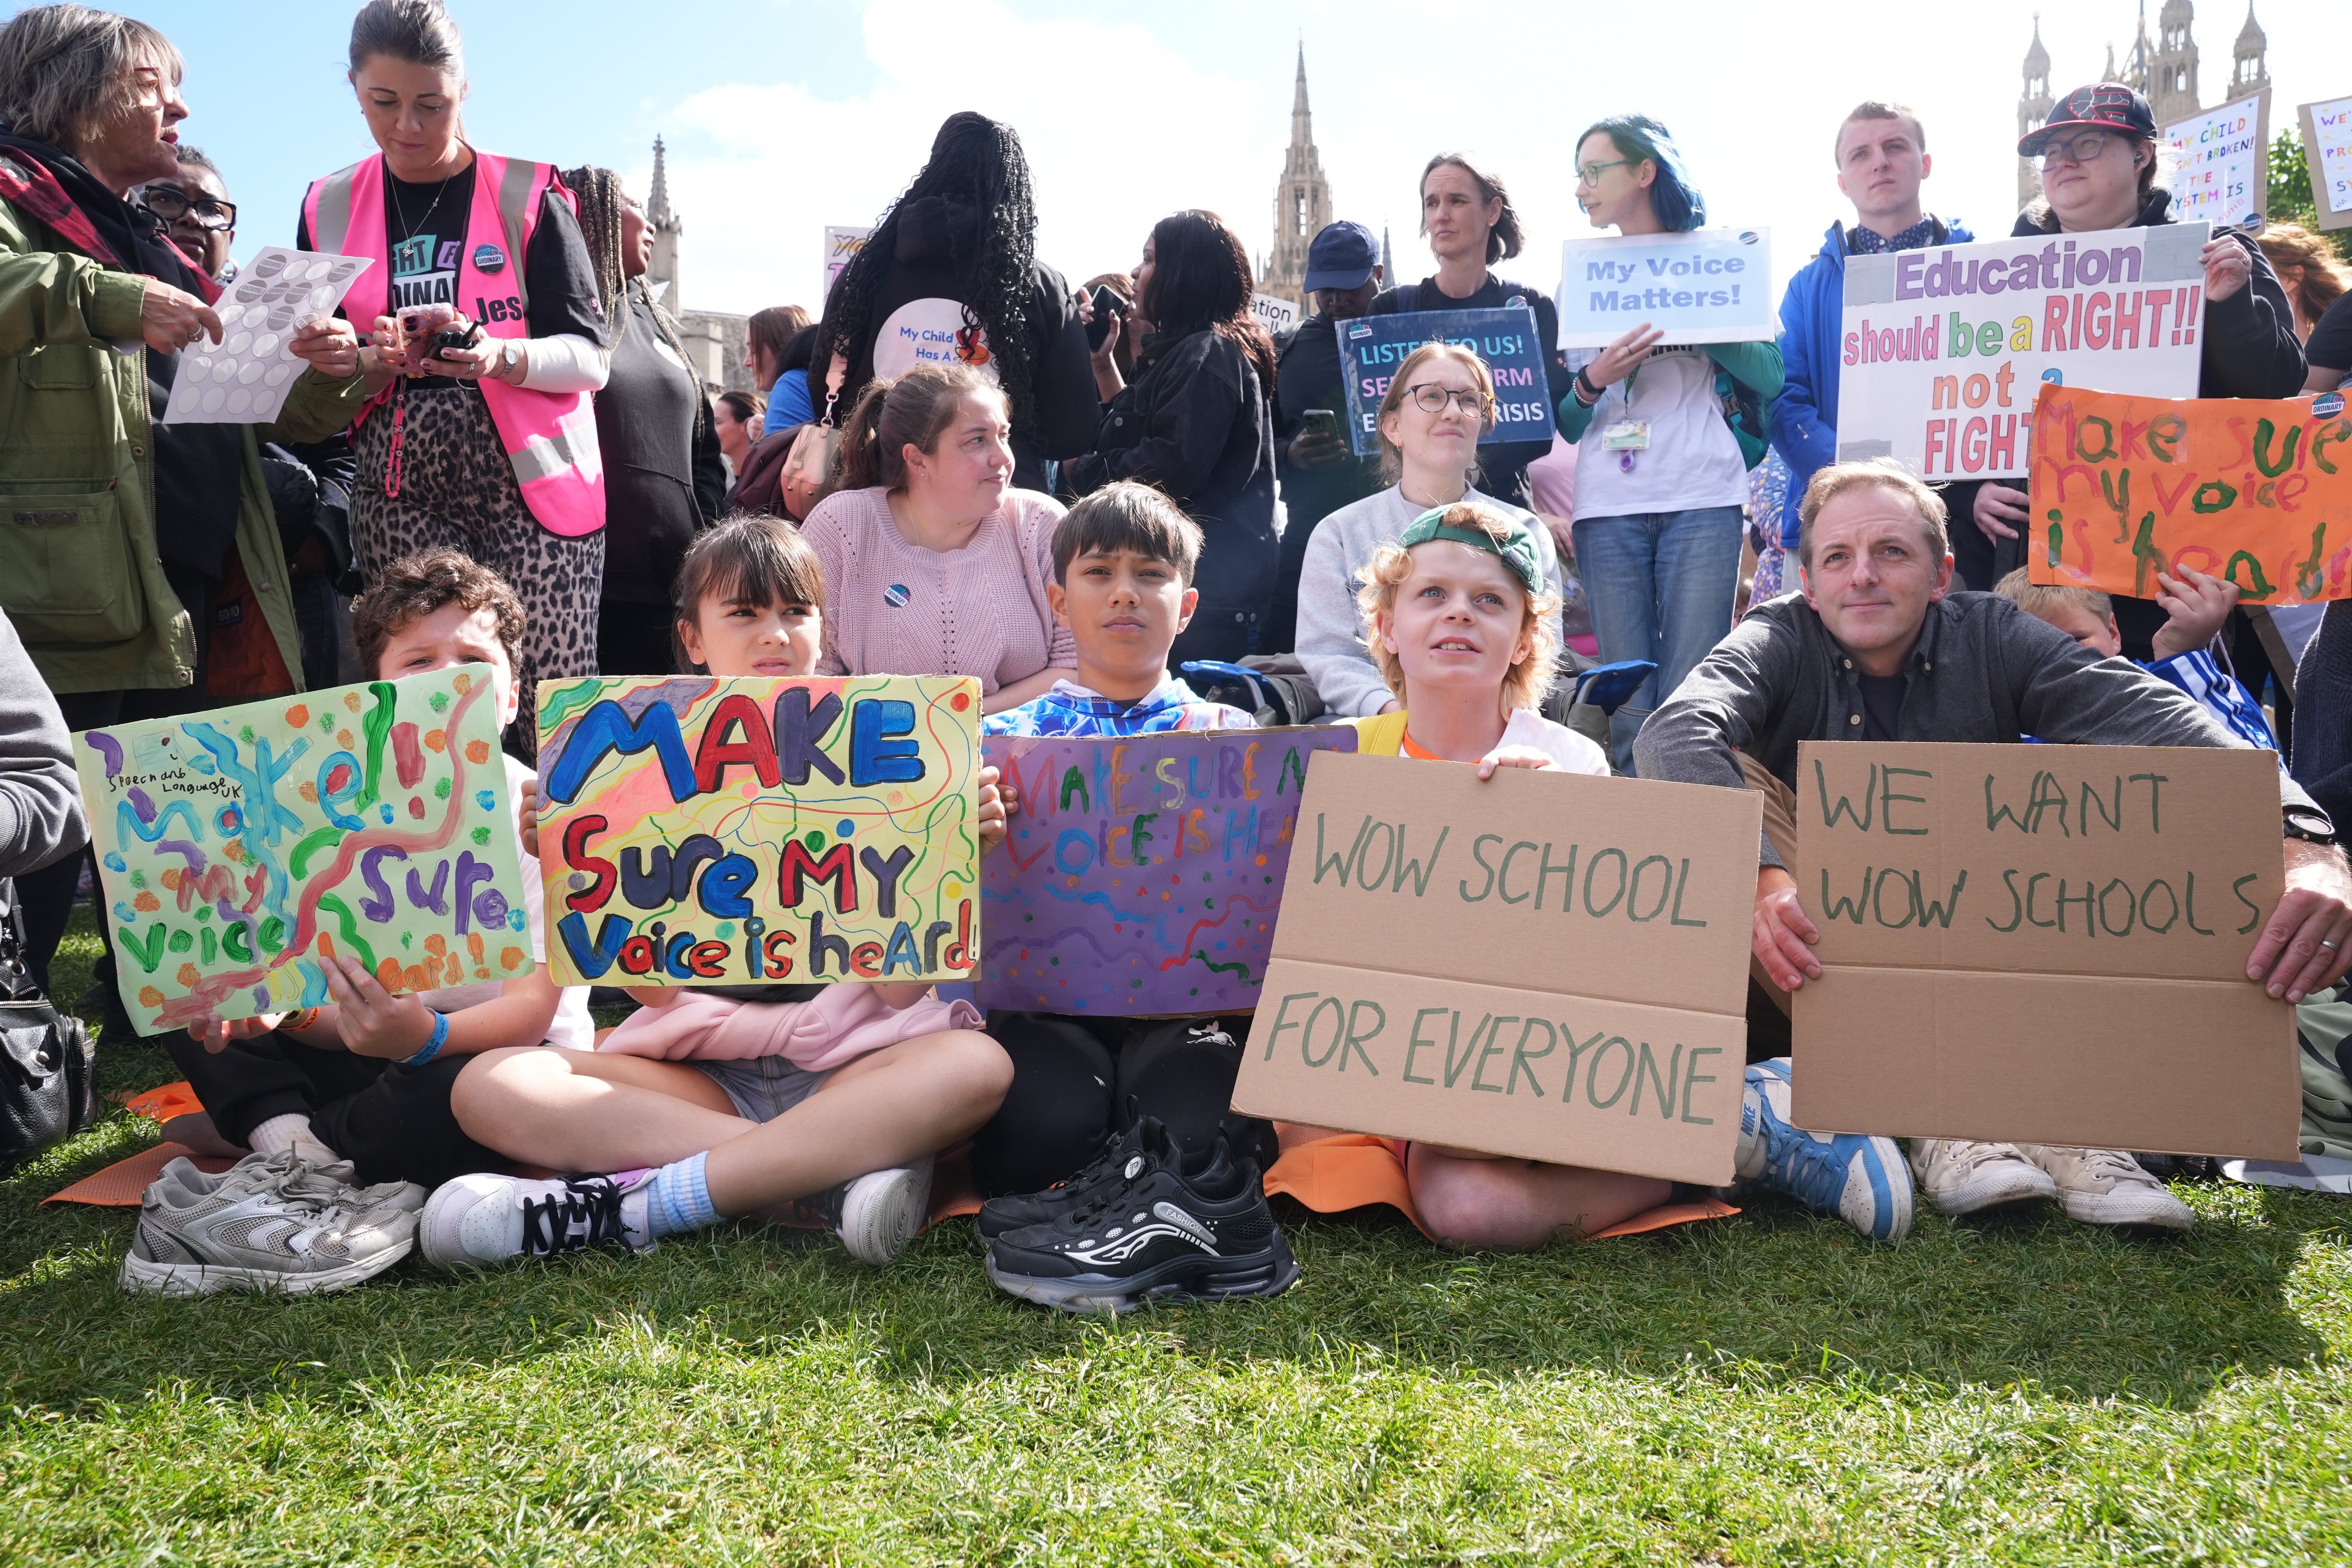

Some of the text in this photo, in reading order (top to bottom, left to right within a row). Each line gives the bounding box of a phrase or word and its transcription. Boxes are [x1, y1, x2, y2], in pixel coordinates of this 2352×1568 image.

[2173, 118, 2245, 149] MY CHILD
[2321, 111, 2351, 125] WE'
[2177, 136, 2254, 171] SN'T BROKEN!
[2190, 172, 2212, 186] THE
[2227, 182, 2243, 198] IS
[2218, 199, 2244, 223] ADHD
[477, 256, 501, 264] ORDINARY
[1587, 255, 1745, 283] My Voice
[1896, 241, 2141, 301] Education
[1250, 300, 1290, 322] ation
[1590, 284, 1740, 311] Matters!
[900, 327, 954, 343] My Child
[1844, 286, 2200, 365] should be a RIGHT!!
[916, 348, 951, 361] Has A
[1485, 335, 1524, 356] US!
[1933, 361, 2015, 410] not
[2316, 396, 2331, 405] FIGHT
[1495, 403, 1544, 422] RISIS
[2313, 403, 2342, 413] ORDINARY
[2038, 399, 2352, 478] Make sure
[2033, 456, 2308, 544] my voice
[2048, 508, 2094, 579] is
[886, 589, 906, 605] ORDINARY
[546, 687, 926, 804] MAKE
[221, 784, 242, 798] UK
[999, 744, 1138, 818] MAKE
[1155, 741, 1262, 810] SURE
[1814, 759, 2169, 838] WE WANT
[1005, 813, 1158, 876] VOICE
[1175, 808, 1210, 858] IS
[563, 815, 915, 919] Sure MY
[1313, 813, 1708, 928] WOW SCHOOL
[1822, 866, 2261, 938] WOW SCHOOLS
[744, 916, 797, 979] is
[1264, 991, 1722, 1125] FOR EVERYONE
[1740, 1103, 1756, 1137] NIKE
[1166, 1209, 1201, 1233] FASHION
